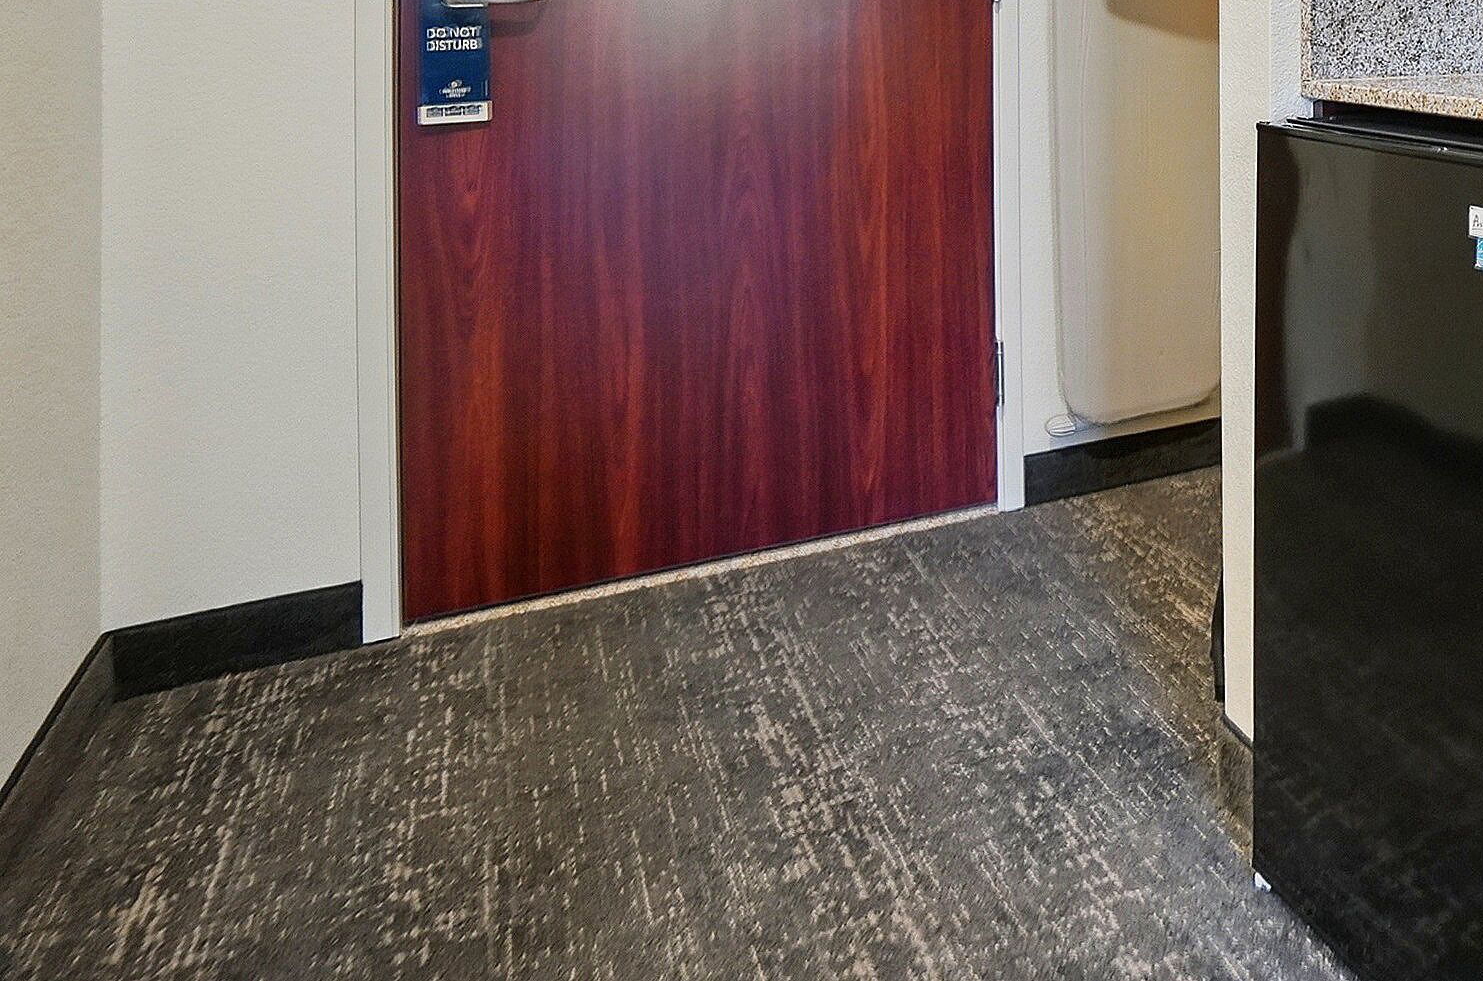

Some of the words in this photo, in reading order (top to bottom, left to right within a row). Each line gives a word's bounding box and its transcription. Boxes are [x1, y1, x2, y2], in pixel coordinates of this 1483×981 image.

[426, 28, 446, 38] DO
[449, 26, 478, 38] NOT
[426, 39, 479, 51] DISTURB
